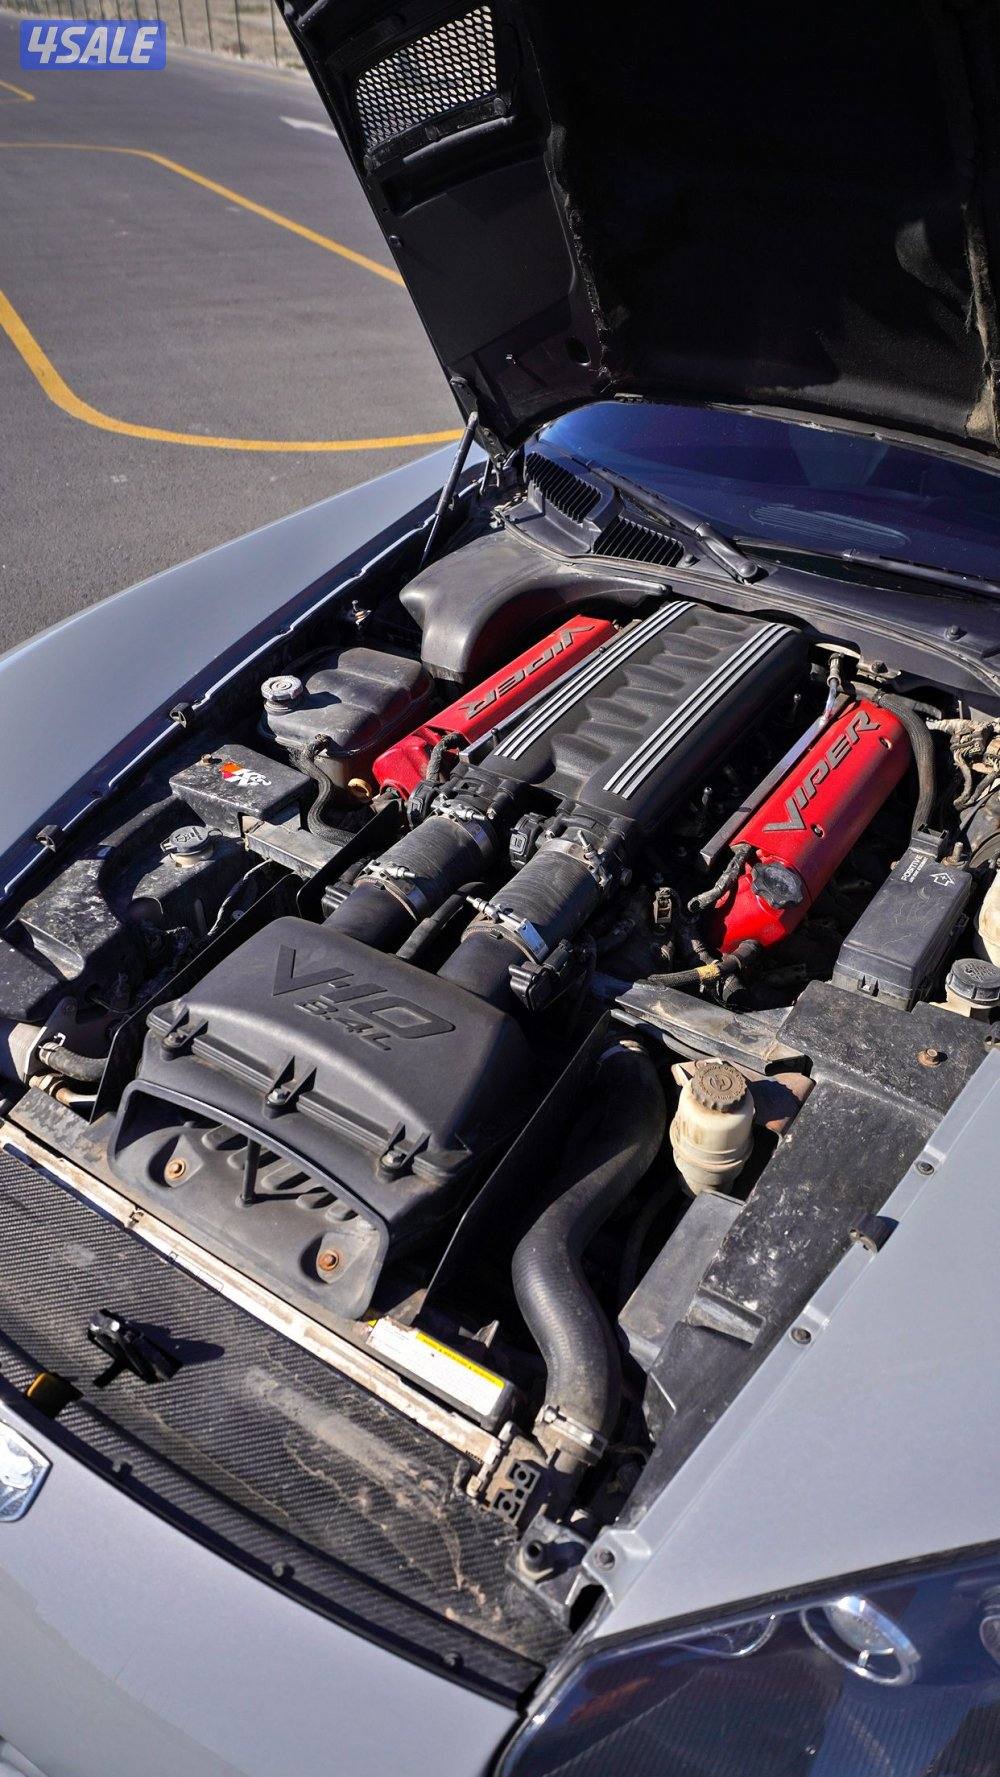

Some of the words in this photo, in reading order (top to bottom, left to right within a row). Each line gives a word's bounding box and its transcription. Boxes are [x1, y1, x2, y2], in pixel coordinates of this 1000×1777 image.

[459, 625, 595, 720] VIPER
[762, 710, 882, 832] VIPER
[294, 1000, 392, 1051] 8.4L
